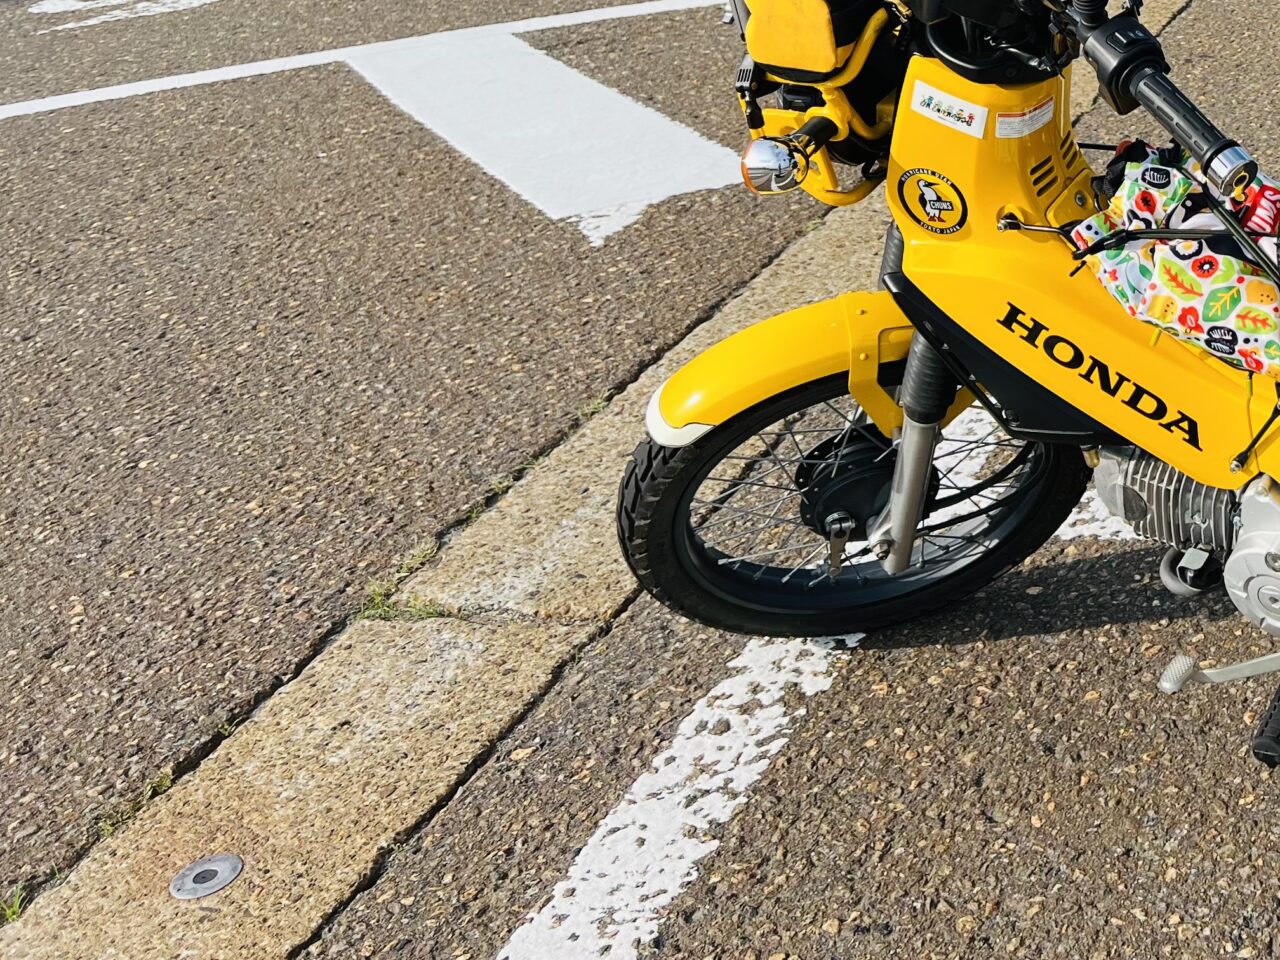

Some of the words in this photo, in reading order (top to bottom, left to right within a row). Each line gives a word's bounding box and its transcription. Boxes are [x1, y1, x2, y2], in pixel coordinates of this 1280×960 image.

[901, 168, 932, 181] HURRICANE
[920, 221, 941, 233] TOKYO
[943, 225, 960, 234] JAPAN
[996, 300, 1203, 452] HONDA
